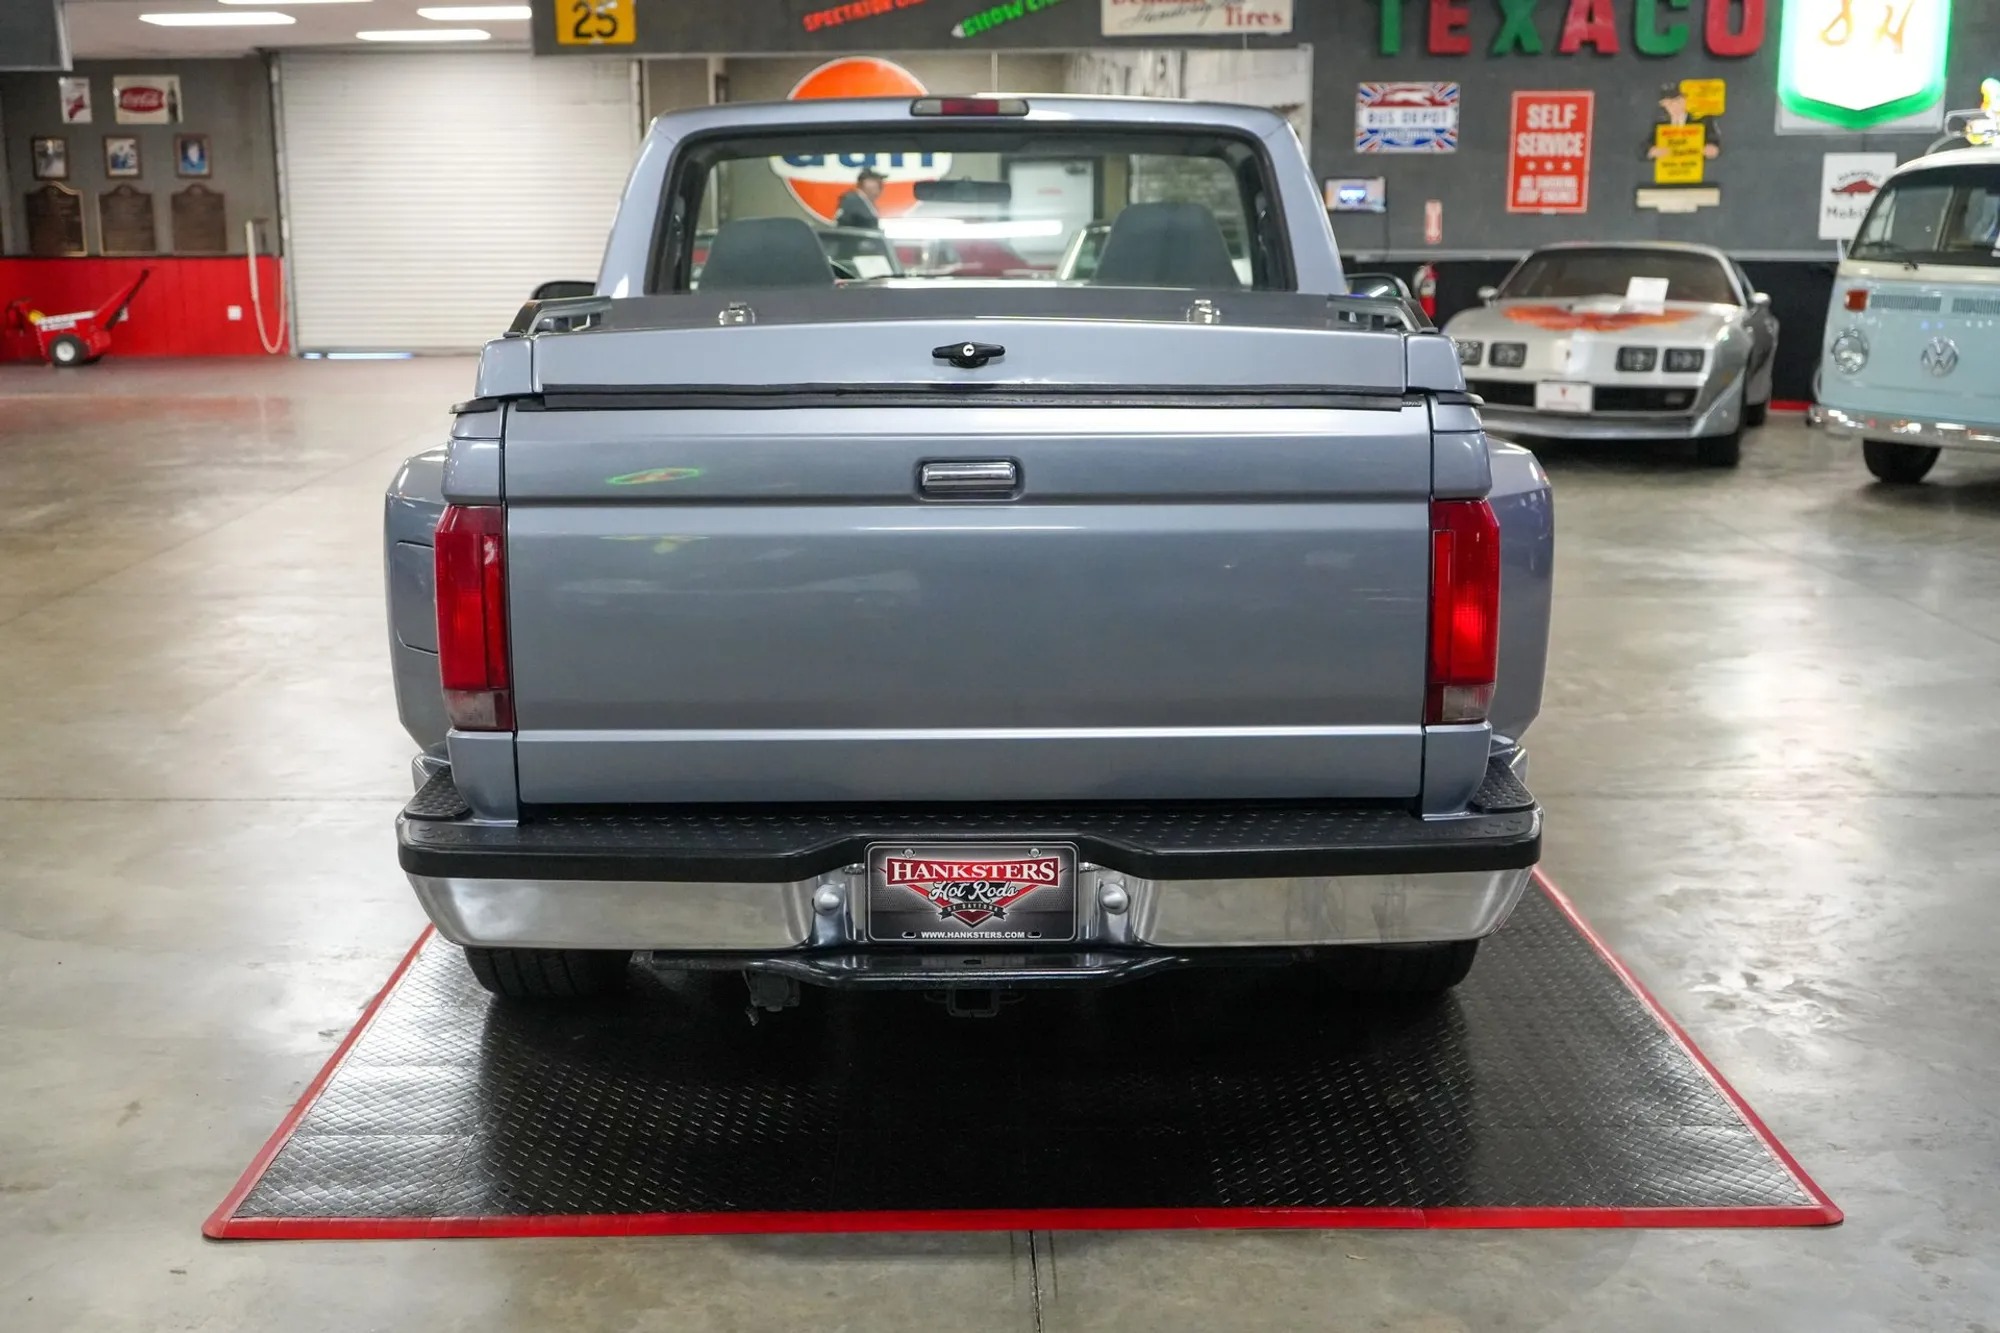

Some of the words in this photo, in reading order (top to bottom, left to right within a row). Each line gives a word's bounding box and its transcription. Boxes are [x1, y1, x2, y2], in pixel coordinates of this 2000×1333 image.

[572, 1, 618, 38] 25
[1224, 5, 1282, 27] Tires
[1526, 103, 1577, 129] SELF
[1517, 132, 1585, 157] SERVICE
[891, 860, 1055, 883] HANKSTERS
[929, 881, 966, 901] Hot
[967, 881, 1018, 903] Rods
[921, 931, 1025, 939] WWW.HANKSTERS.COM
